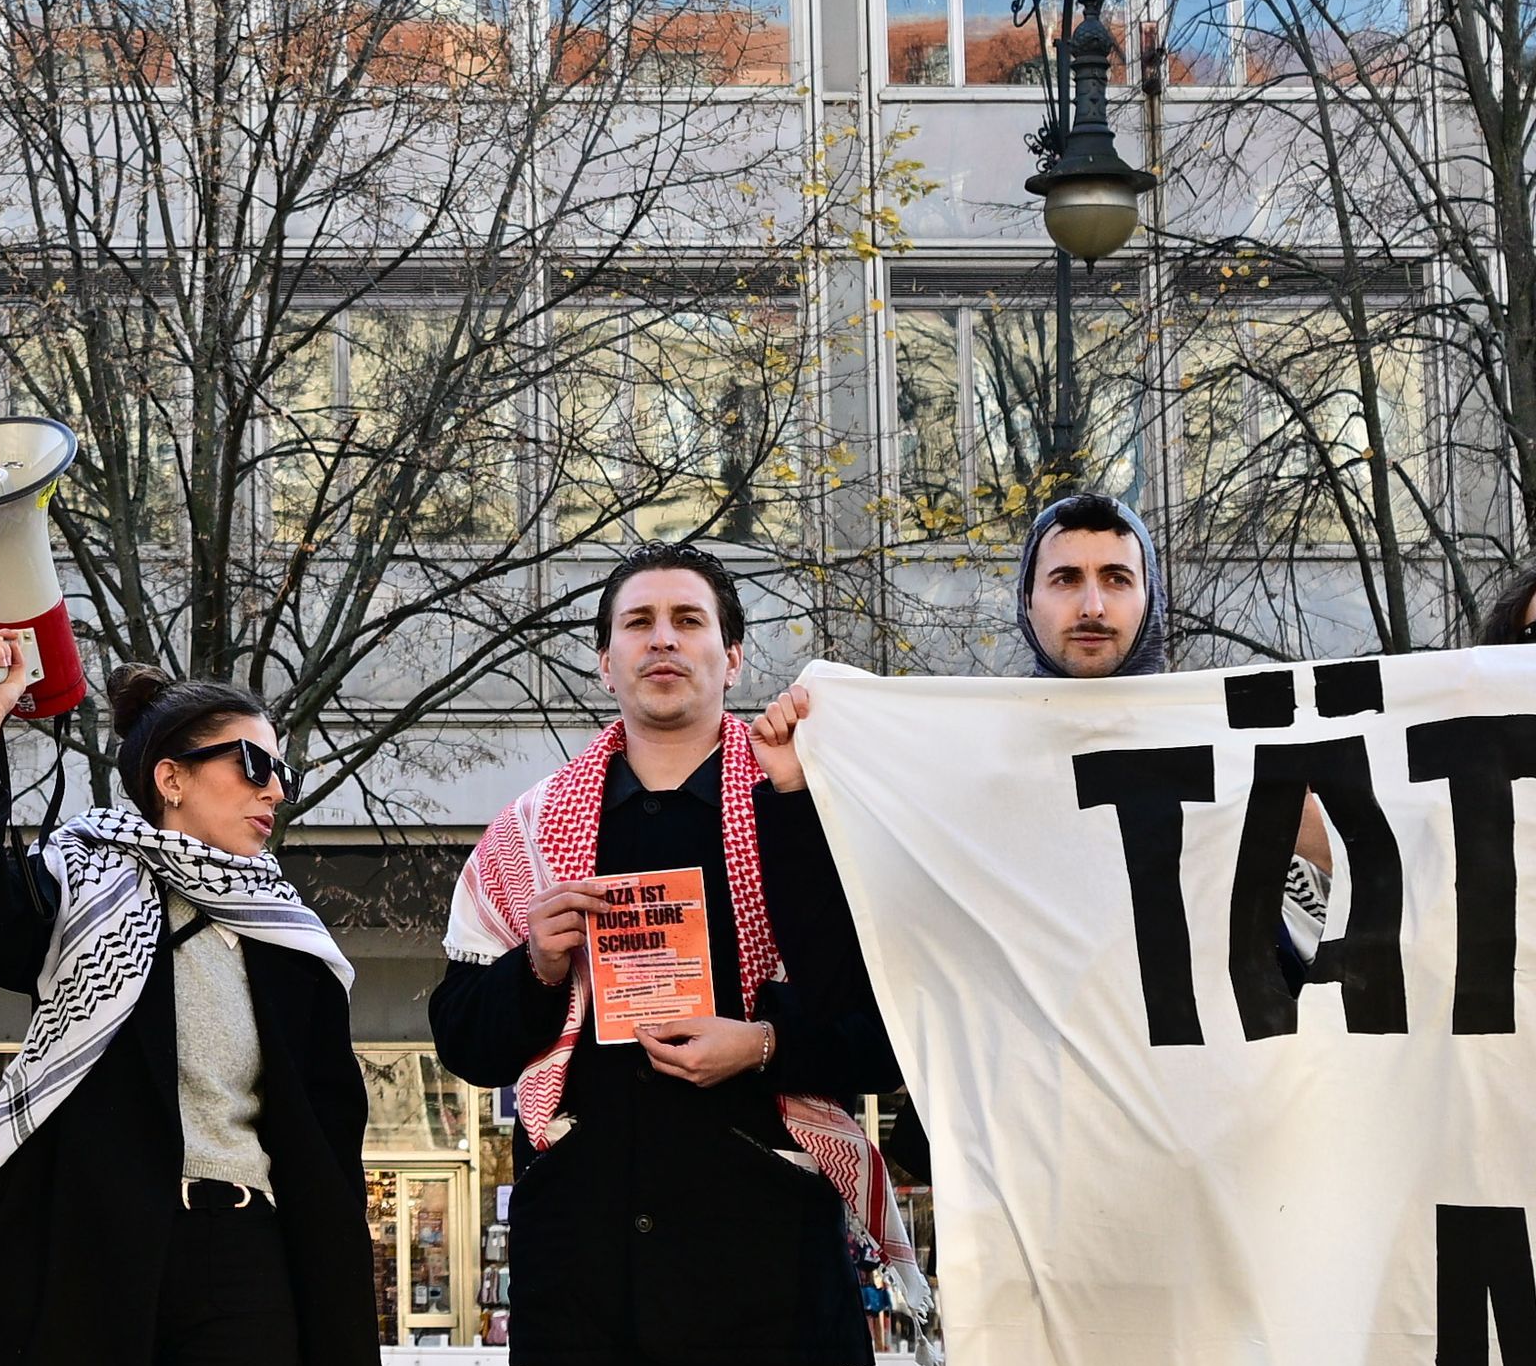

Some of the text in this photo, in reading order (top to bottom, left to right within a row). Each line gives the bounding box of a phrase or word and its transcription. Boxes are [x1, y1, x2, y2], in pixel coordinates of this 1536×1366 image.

[604, 886, 635, 906] AZA
[640, 884, 666, 903] IST
[596, 907, 684, 930] AUCH EURE
[598, 931, 666, 953] SCHULD!
